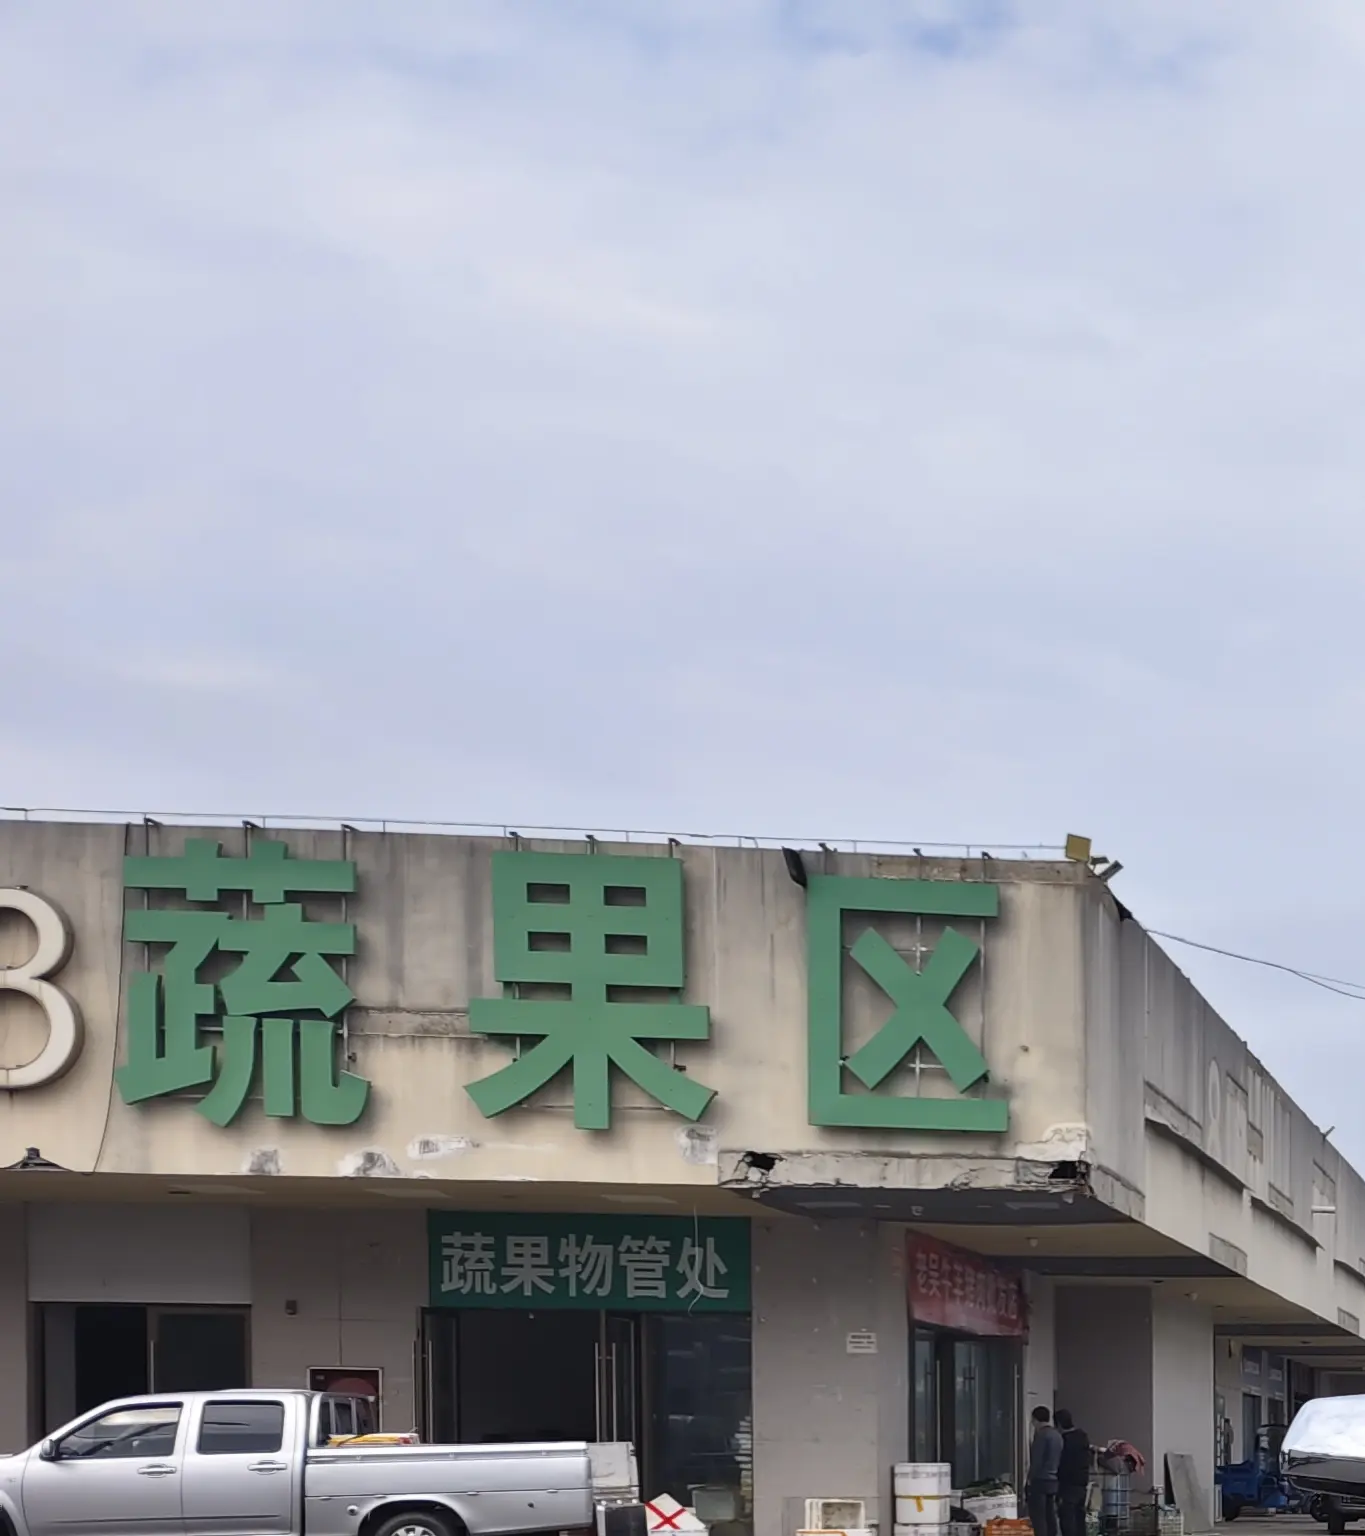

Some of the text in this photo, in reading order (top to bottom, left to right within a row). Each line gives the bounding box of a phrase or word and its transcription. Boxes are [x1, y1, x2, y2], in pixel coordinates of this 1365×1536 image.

[441, 1231, 730, 1299] 蔬果物管处
